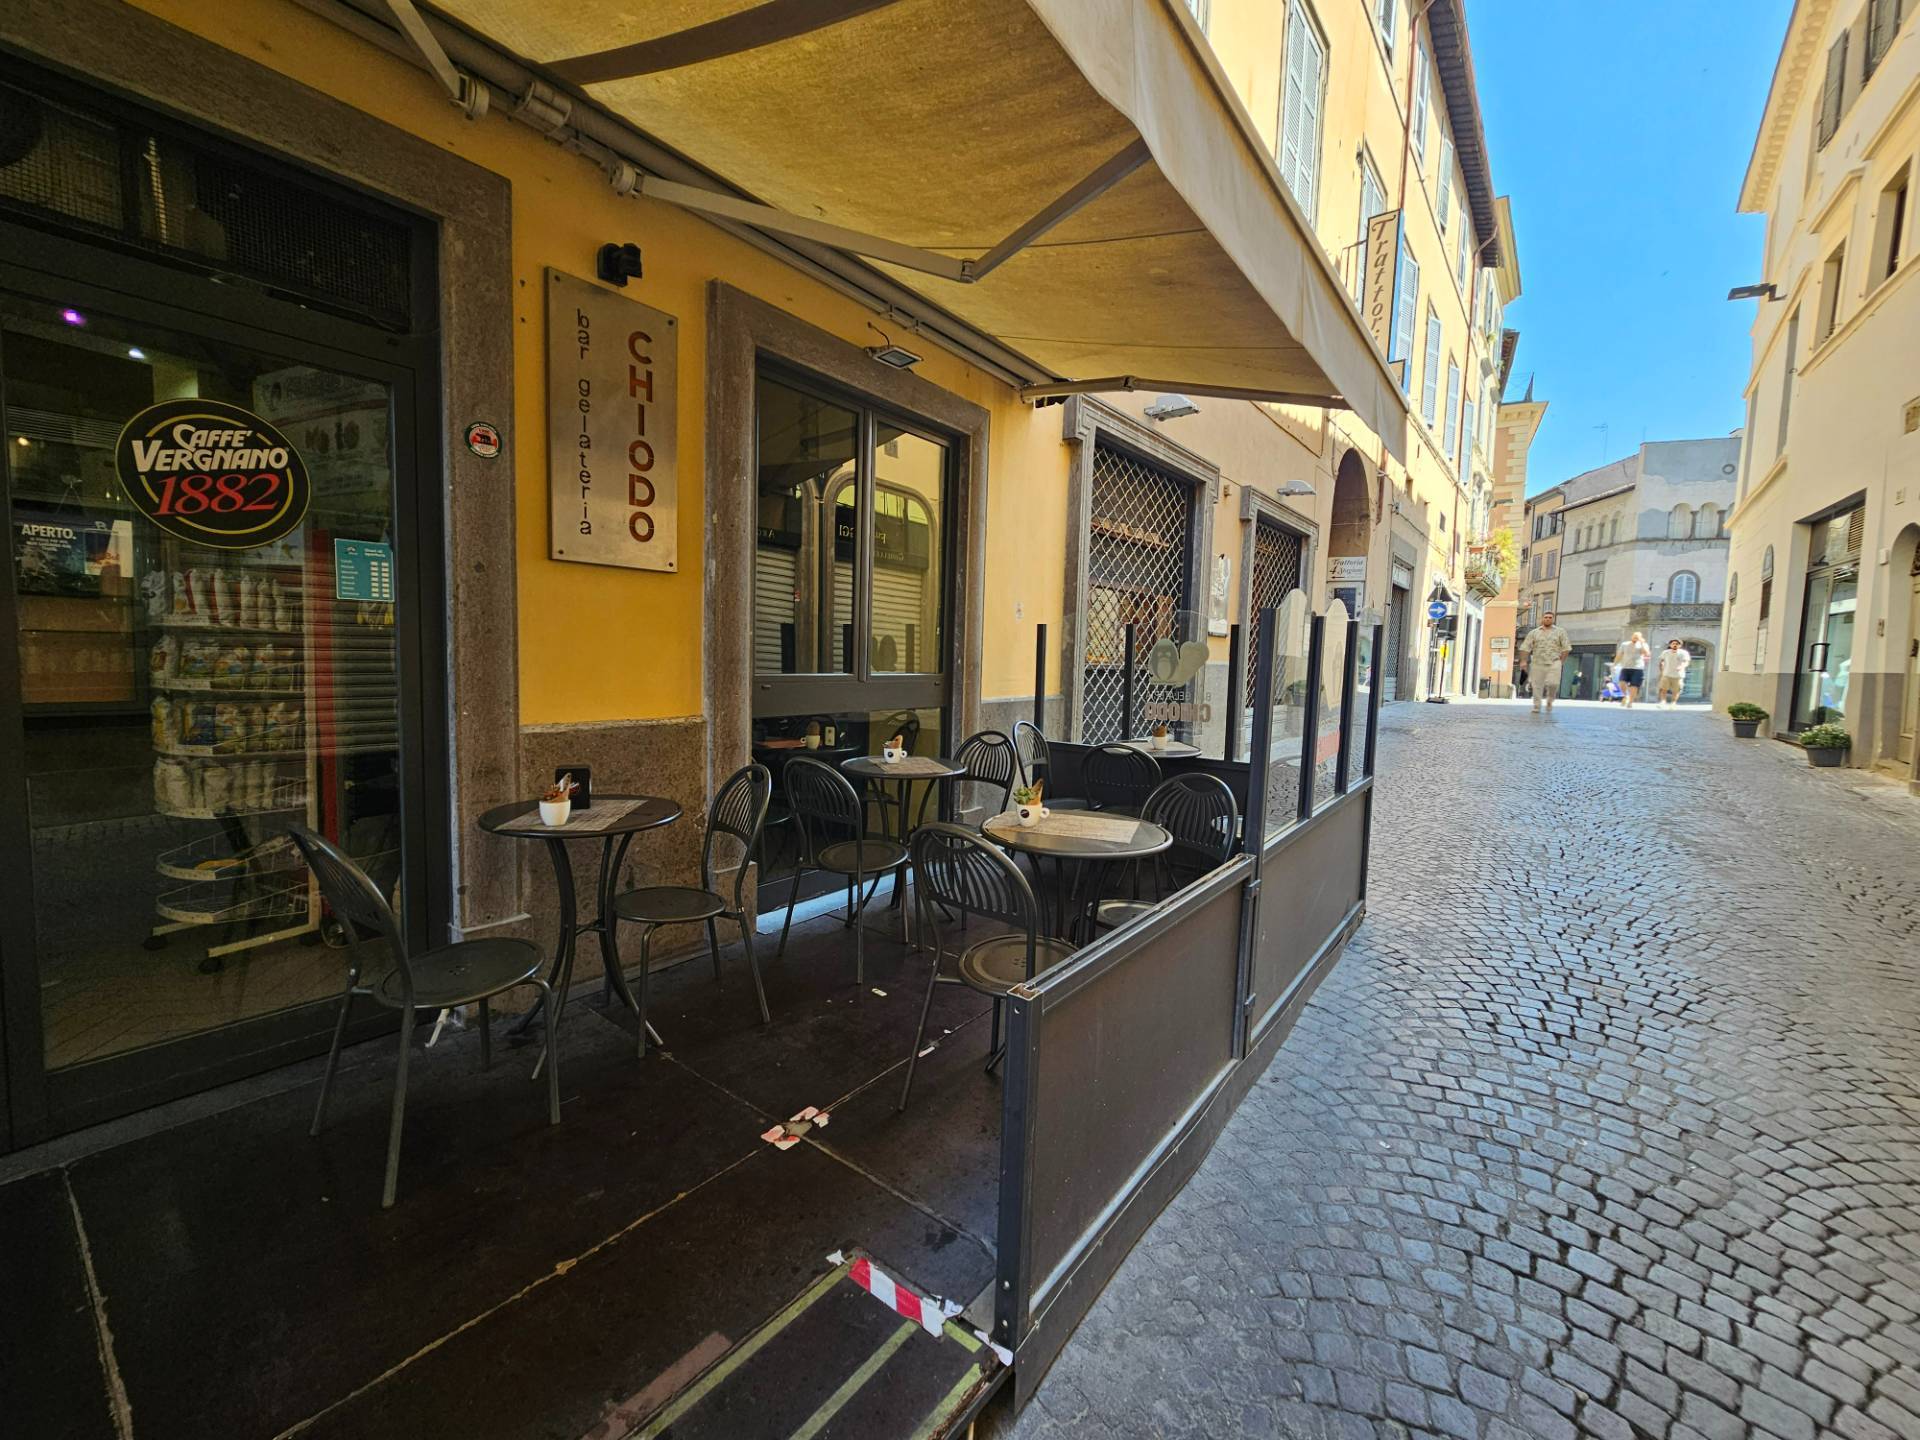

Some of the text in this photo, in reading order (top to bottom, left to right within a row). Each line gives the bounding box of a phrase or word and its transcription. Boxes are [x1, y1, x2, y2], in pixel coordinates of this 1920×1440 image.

[577, 308, 592, 535] bar gelateria
[628, 331, 656, 543] CHIODO
[131, 439, 289, 472] VERGNANO
[151, 473, 281, 517] 1882
[21, 523, 77, 540] APERTO.
